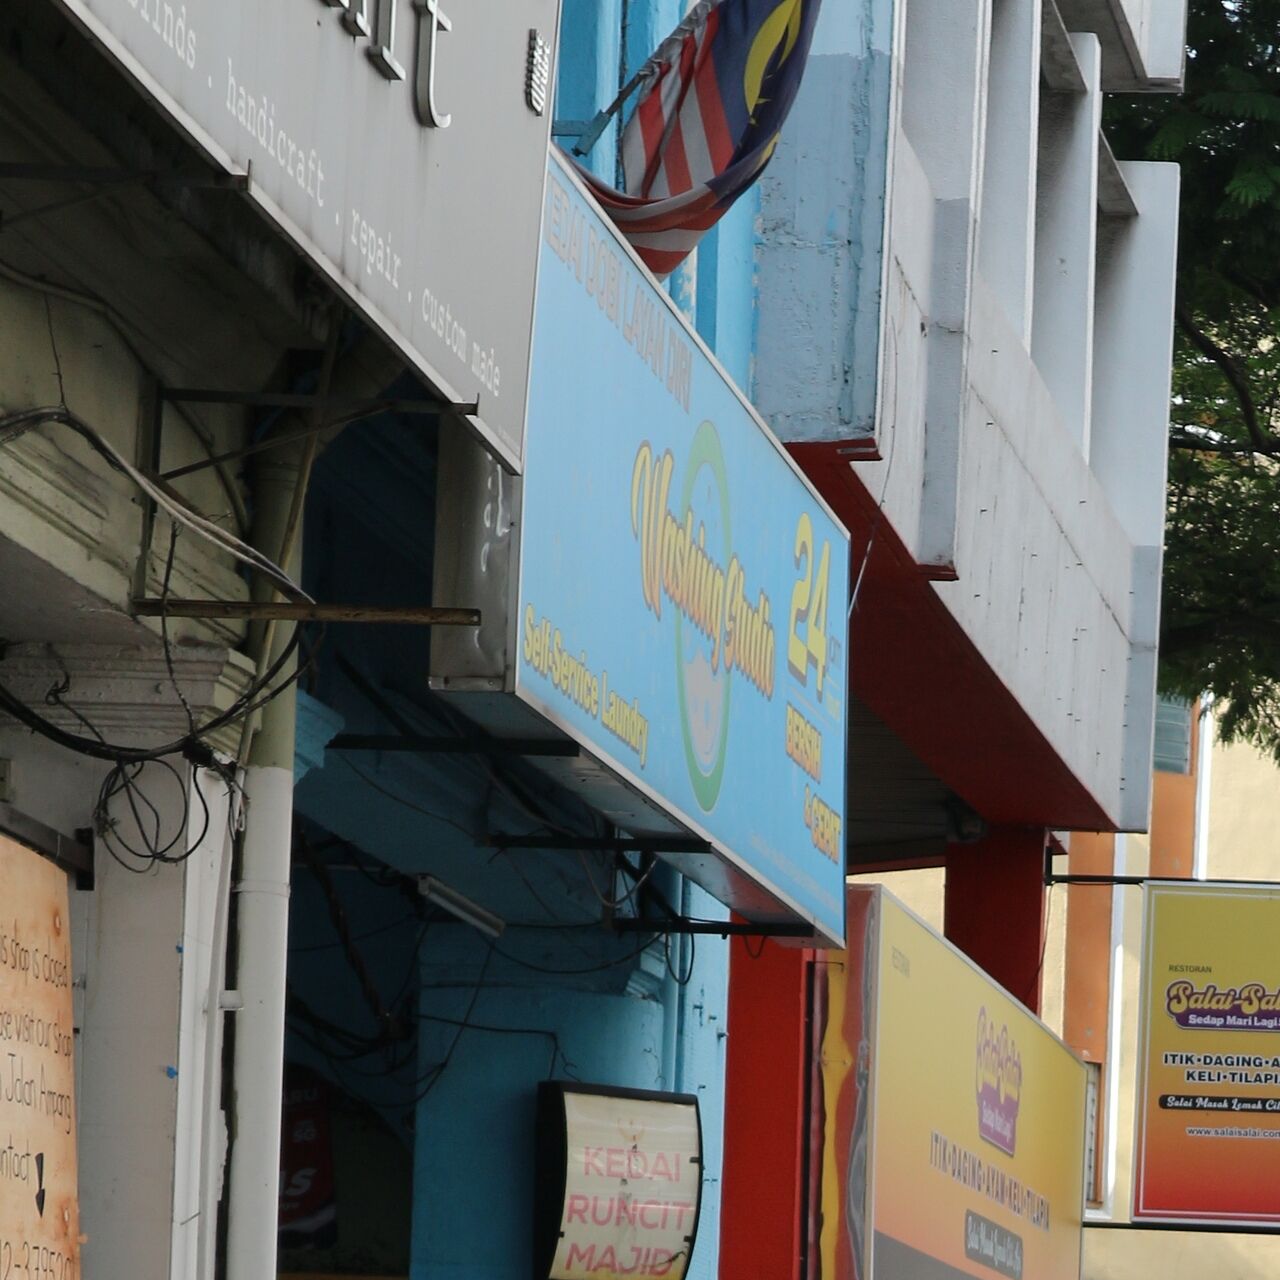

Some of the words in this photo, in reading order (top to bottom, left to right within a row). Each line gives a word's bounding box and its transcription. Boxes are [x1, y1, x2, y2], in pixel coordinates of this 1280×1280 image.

[226, 57, 325, 207] handicraft
[351, 208, 401, 290] repair
[422, 287, 466, 363] custom
[471, 341, 501, 397] made
[631, 440, 724, 676] Washing
[724, 552, 776, 702] Studio
[788, 511, 831, 704] 24
[524, 602, 600, 720] Self-Service
[602, 670, 649, 770] Laundry
[785, 700, 822, 785] BERSIH
[1168, 964, 1213, 974] RESTORAN
[1188, 1014, 1225, 1027] Sedap
[1226, 1015, 1252, 1026] Mari
[6, 1053, 36, 1114] Jalan
[1166, 1095, 1193, 1108] Salai
[1195, 1097, 1229, 1110] Masak
[1231, 1098, 1263, 1112] Lemak
[583, 1145, 682, 1183] KEDAI
[566, 1192, 692, 1231] RUNCIT
[564, 1241, 674, 1277] MAJID
